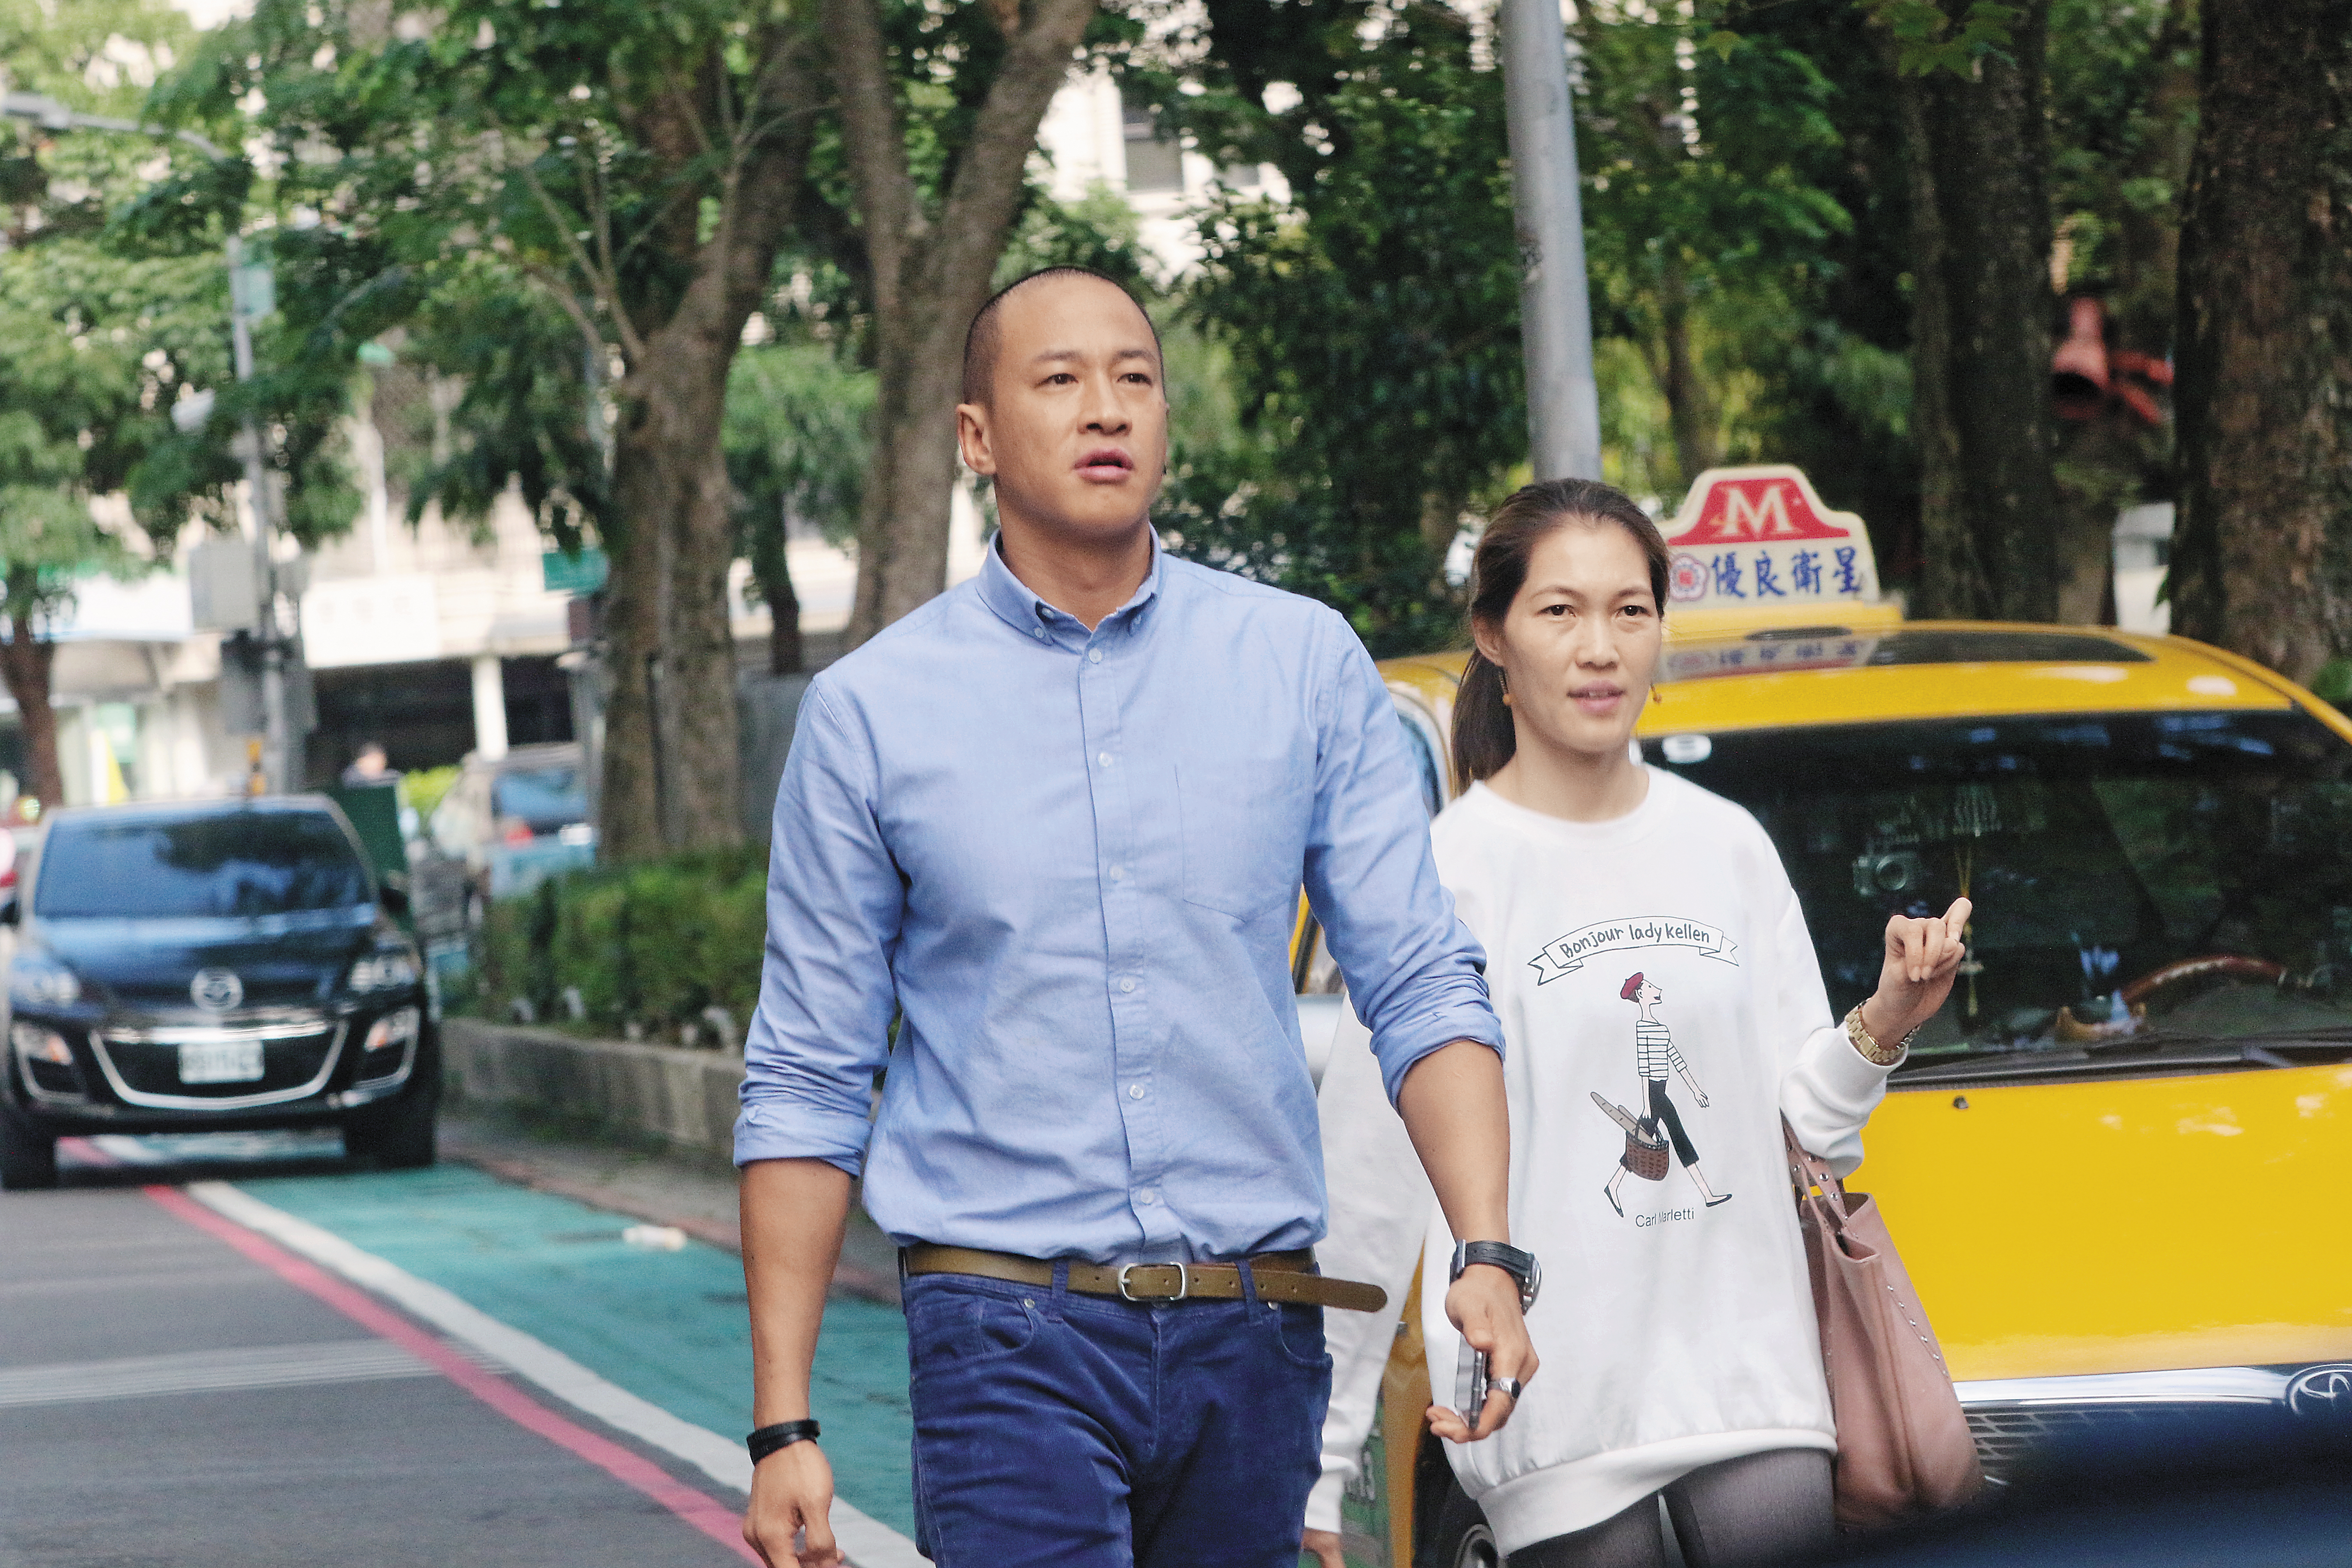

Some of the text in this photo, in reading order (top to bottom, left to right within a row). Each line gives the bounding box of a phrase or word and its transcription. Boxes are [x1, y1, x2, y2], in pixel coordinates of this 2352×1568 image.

[1713, 484, 1804, 538] M
[1712, 545, 1861, 598] 優良衛星
[1559, 922, 1710, 958] Bonjour lady kellen
[1635, 1212, 1657, 1228] Carl
